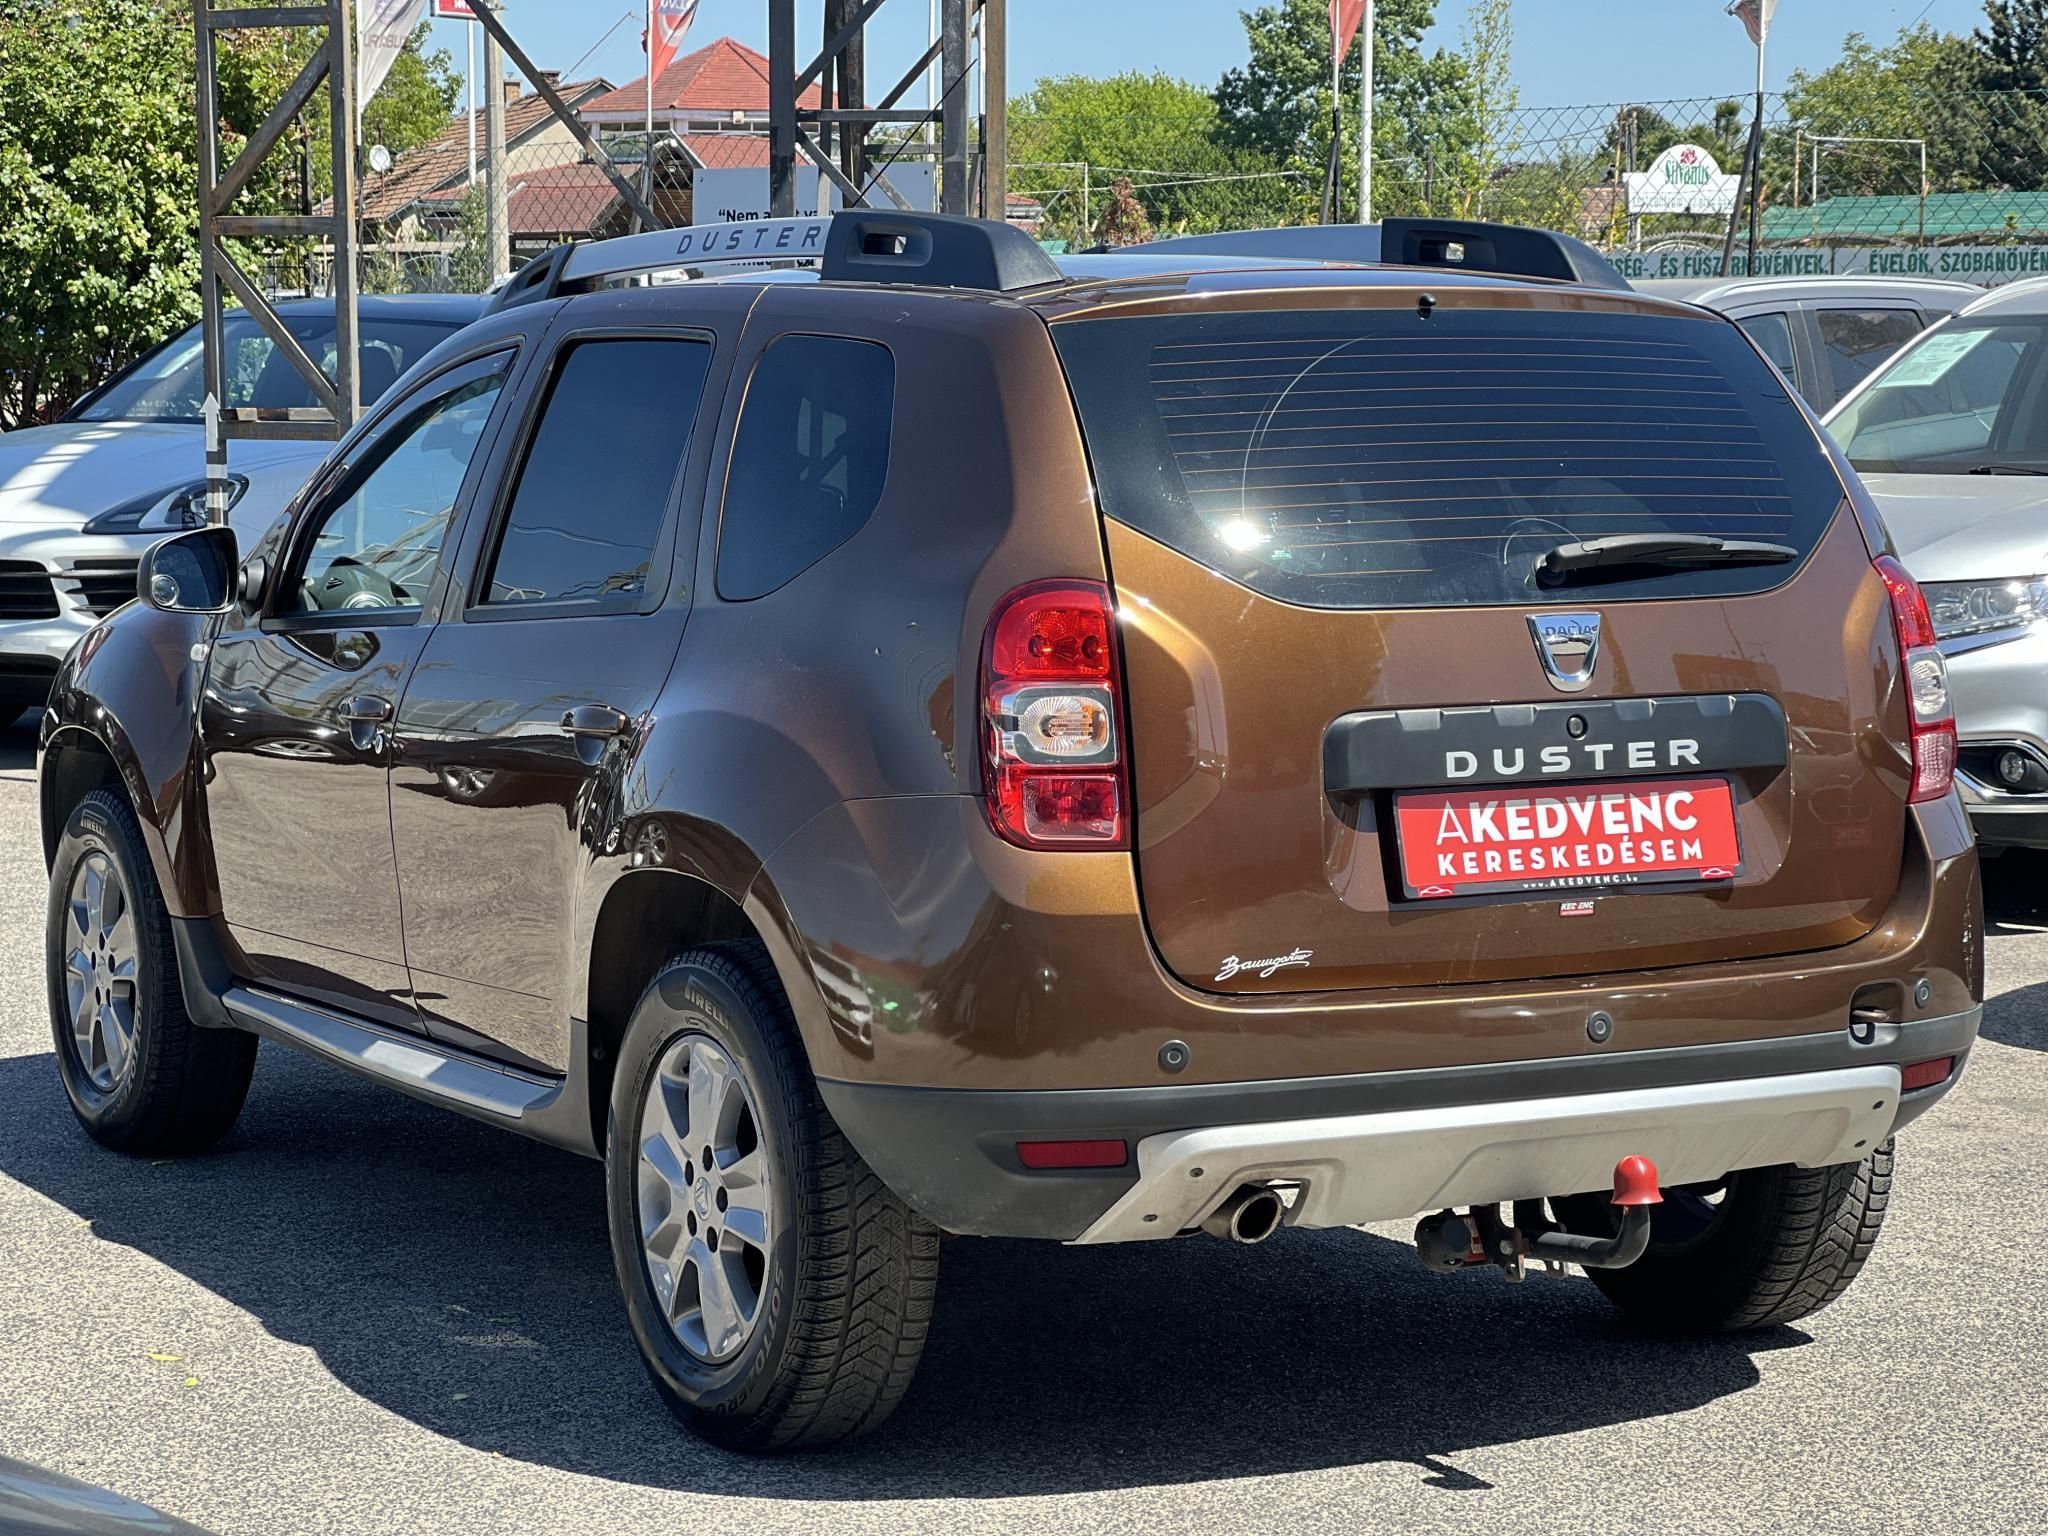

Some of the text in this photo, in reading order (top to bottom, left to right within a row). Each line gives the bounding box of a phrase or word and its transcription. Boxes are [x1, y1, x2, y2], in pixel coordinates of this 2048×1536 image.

[1665, 159, 1711, 185] Silvanus
[676, 226, 821, 254] DUSTER
[1659, 253, 1680, 277] ÉS
[1683, 249, 1829, 277] FŰSZRNÖVÉNYEK.
[1868, 248, 1934, 275] ÉVELŐK,
[1545, 624, 1593, 637] DACIA
[1445, 739, 1701, 778] DUSTER
[80, 808, 108, 838] PIRELLI
[1437, 835, 1703, 877] KERESKEDÉSEM
[684, 974, 730, 1030] PIRELLI
